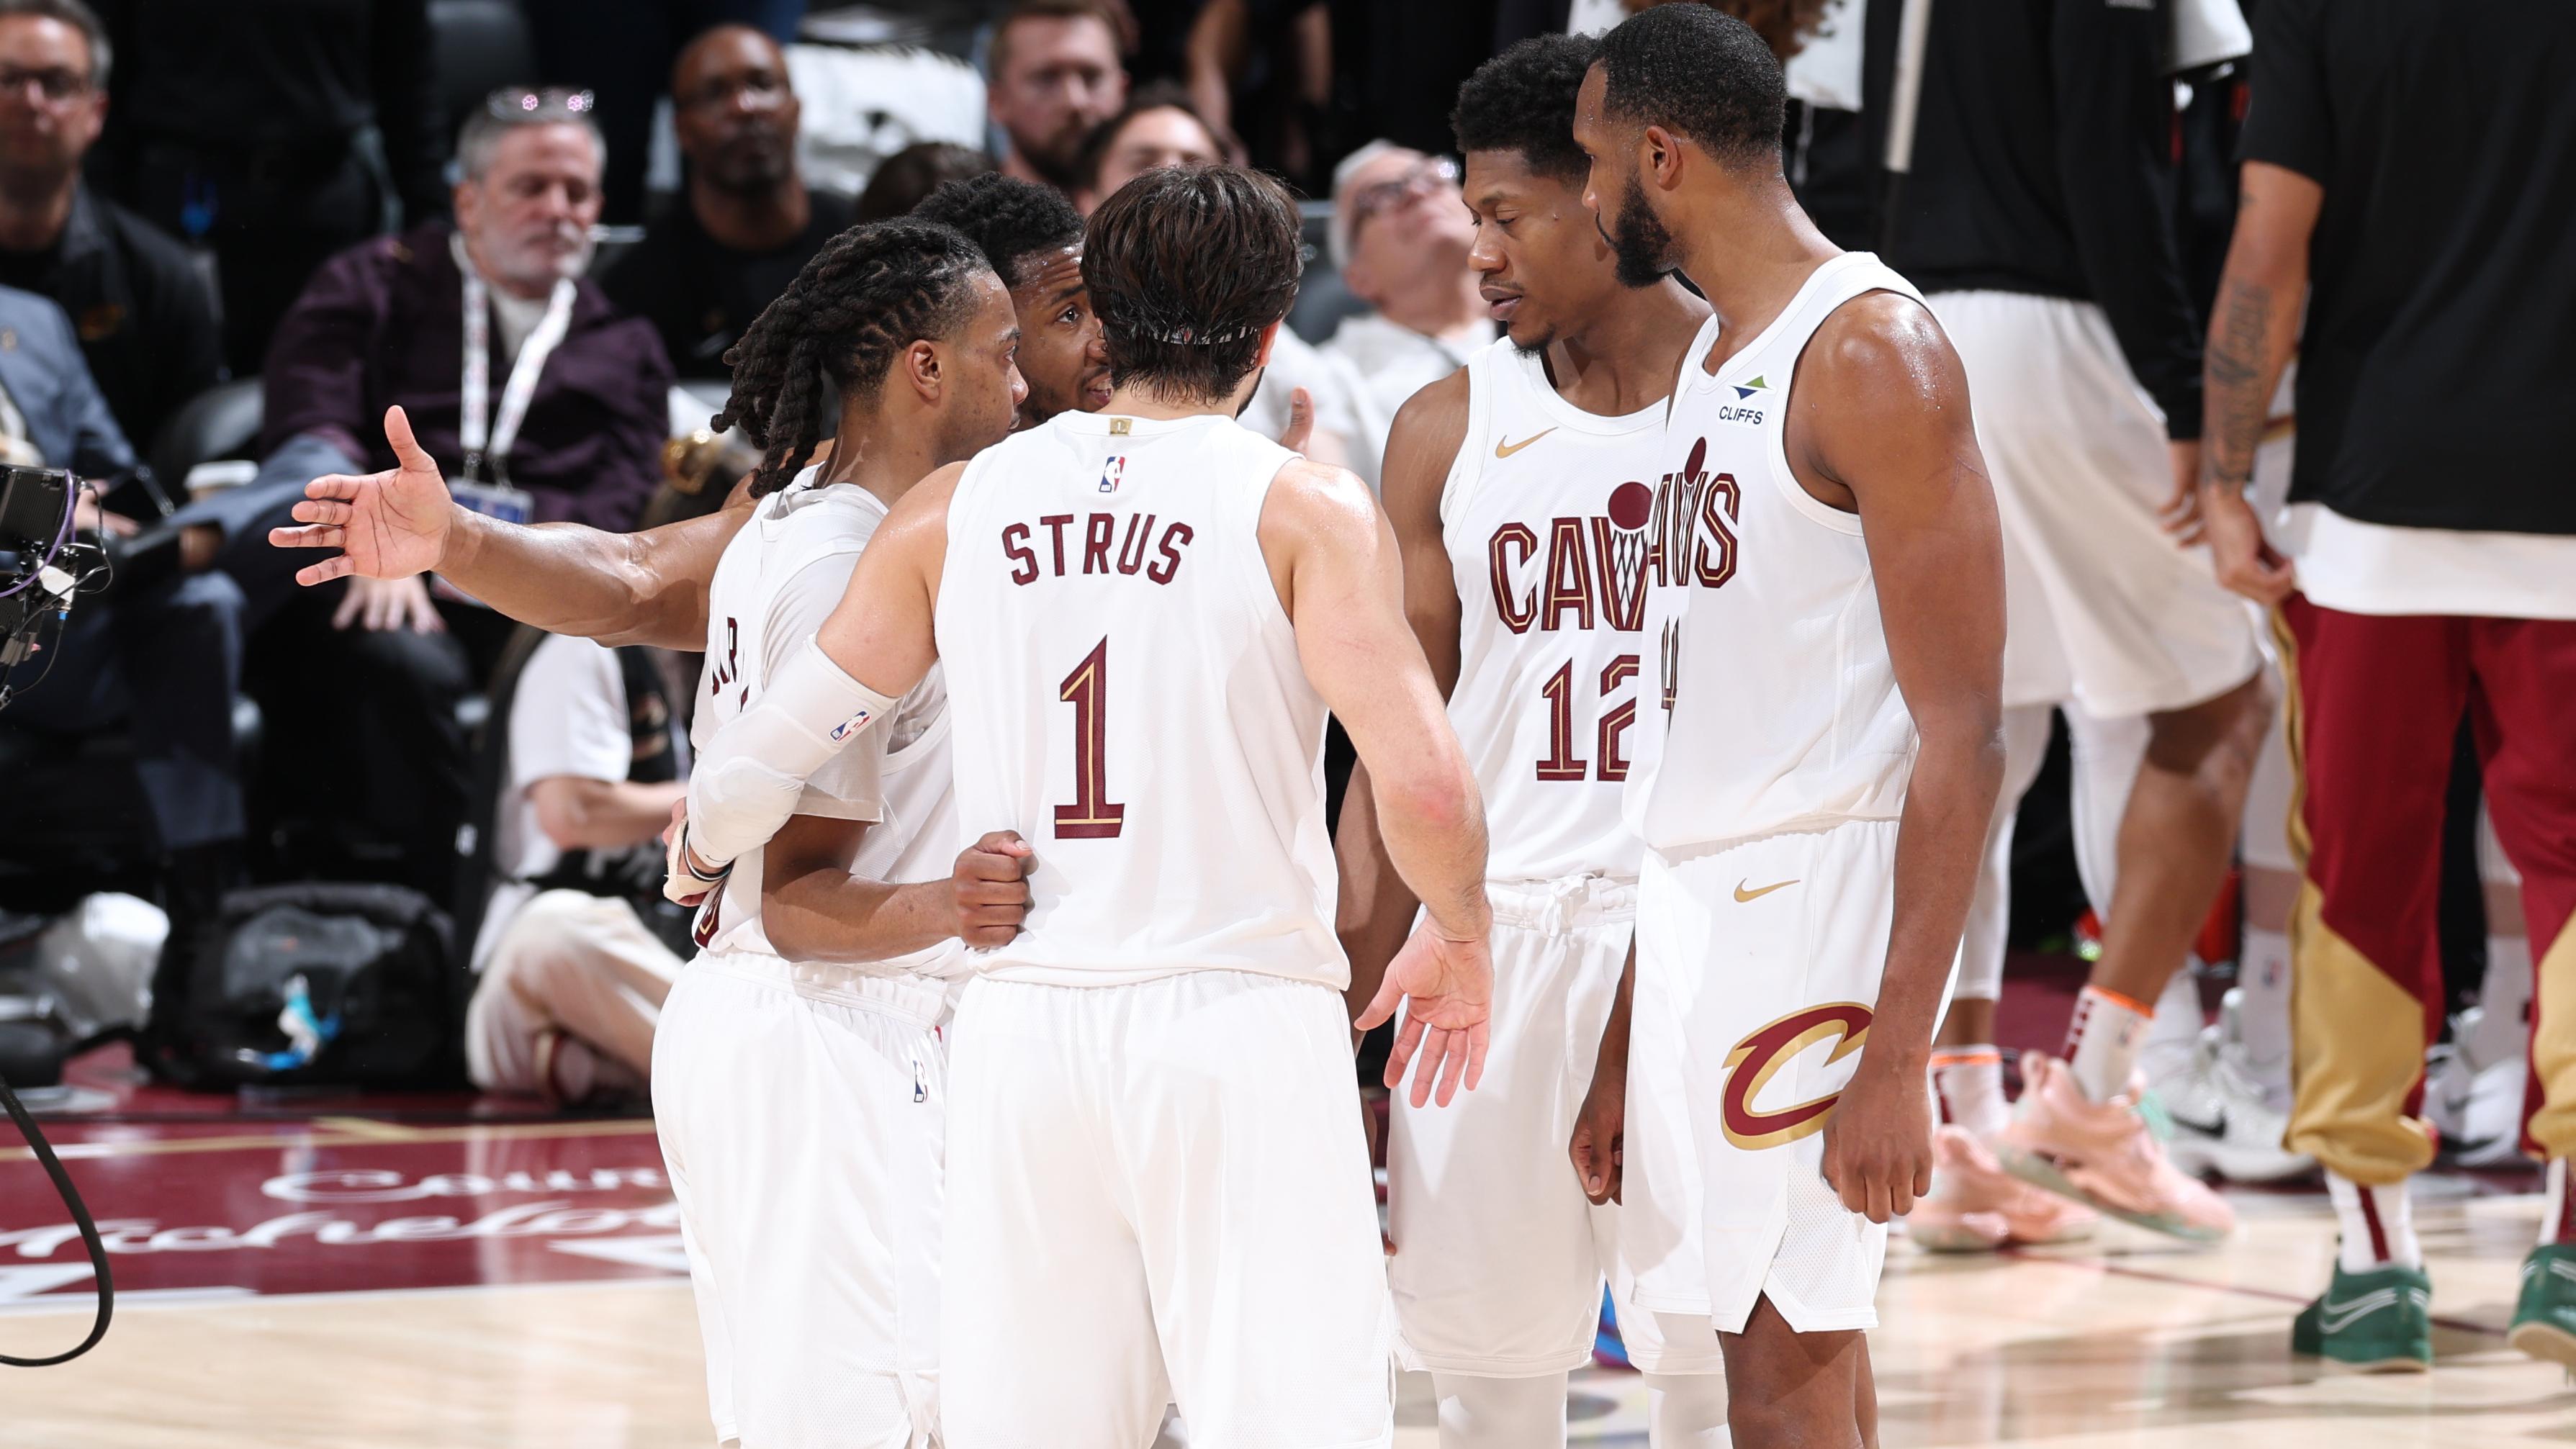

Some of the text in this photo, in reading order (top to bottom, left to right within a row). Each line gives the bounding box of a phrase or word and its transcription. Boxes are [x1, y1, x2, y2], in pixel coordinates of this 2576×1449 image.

[1719, 405, 1764, 425] CLIFFS
[1001, 513, 1194, 587] STRUS
[1488, 515, 1655, 635] CAV
[1649, 471, 1741, 589] AVS
[1053, 633, 1125, 840] 1
[1536, 654, 1641, 782] 12
